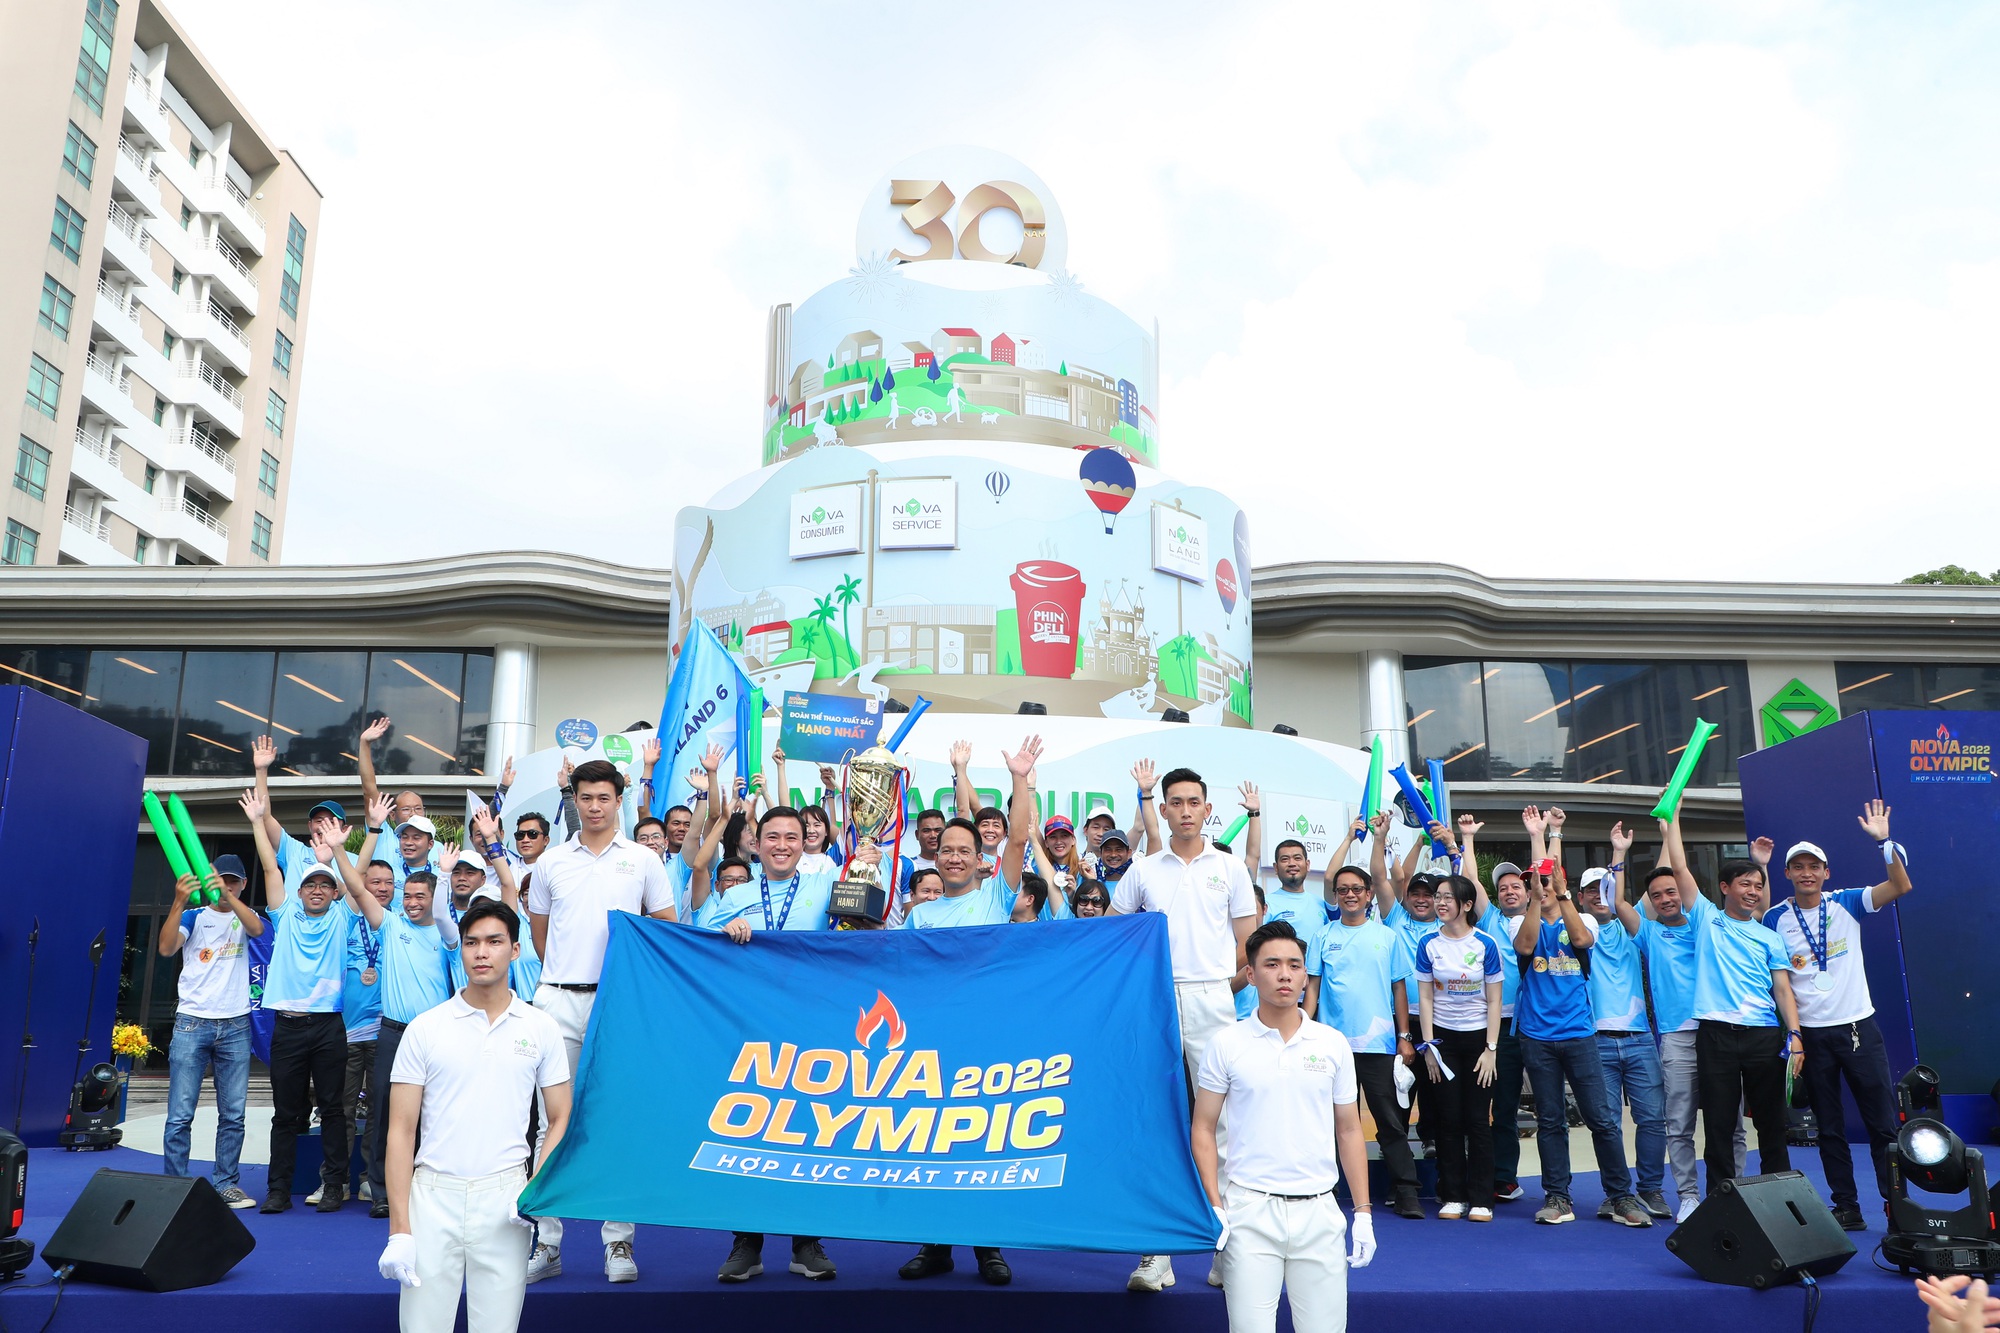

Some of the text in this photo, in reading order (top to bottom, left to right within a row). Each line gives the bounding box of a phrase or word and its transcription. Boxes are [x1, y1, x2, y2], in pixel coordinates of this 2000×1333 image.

[887, 180, 1045, 269] 30
[800, 525, 845, 540] CONSUMER
[892, 519, 942, 531] SERVICE
[1168, 543, 1201, 561] LAND
[1033, 610, 1065, 624] PHIN
[1033, 621, 1065, 635] DELI
[715, 683, 729, 700] 6
[789, 711, 809, 720] ĐOÀN
[823, 715, 841, 723] THAO
[842, 715, 860, 725] XUẤT
[860, 717, 874, 726] SẮC
[796, 723, 866, 739] HẠNG NHẤT
[1910, 739, 1991, 755] NOVA 2022
[1909, 755, 1990, 772] OLYMPIC
[837, 897, 855, 909] HẠNG
[728, 1041, 1074, 1100] NOVA 2022
[707, 1091, 1066, 1155] OLYMPIC
[716, 1153, 1041, 1185] HỢP LỰC PHÁT TRIỂN
[1927, 1218, 1948, 1228] SVT
